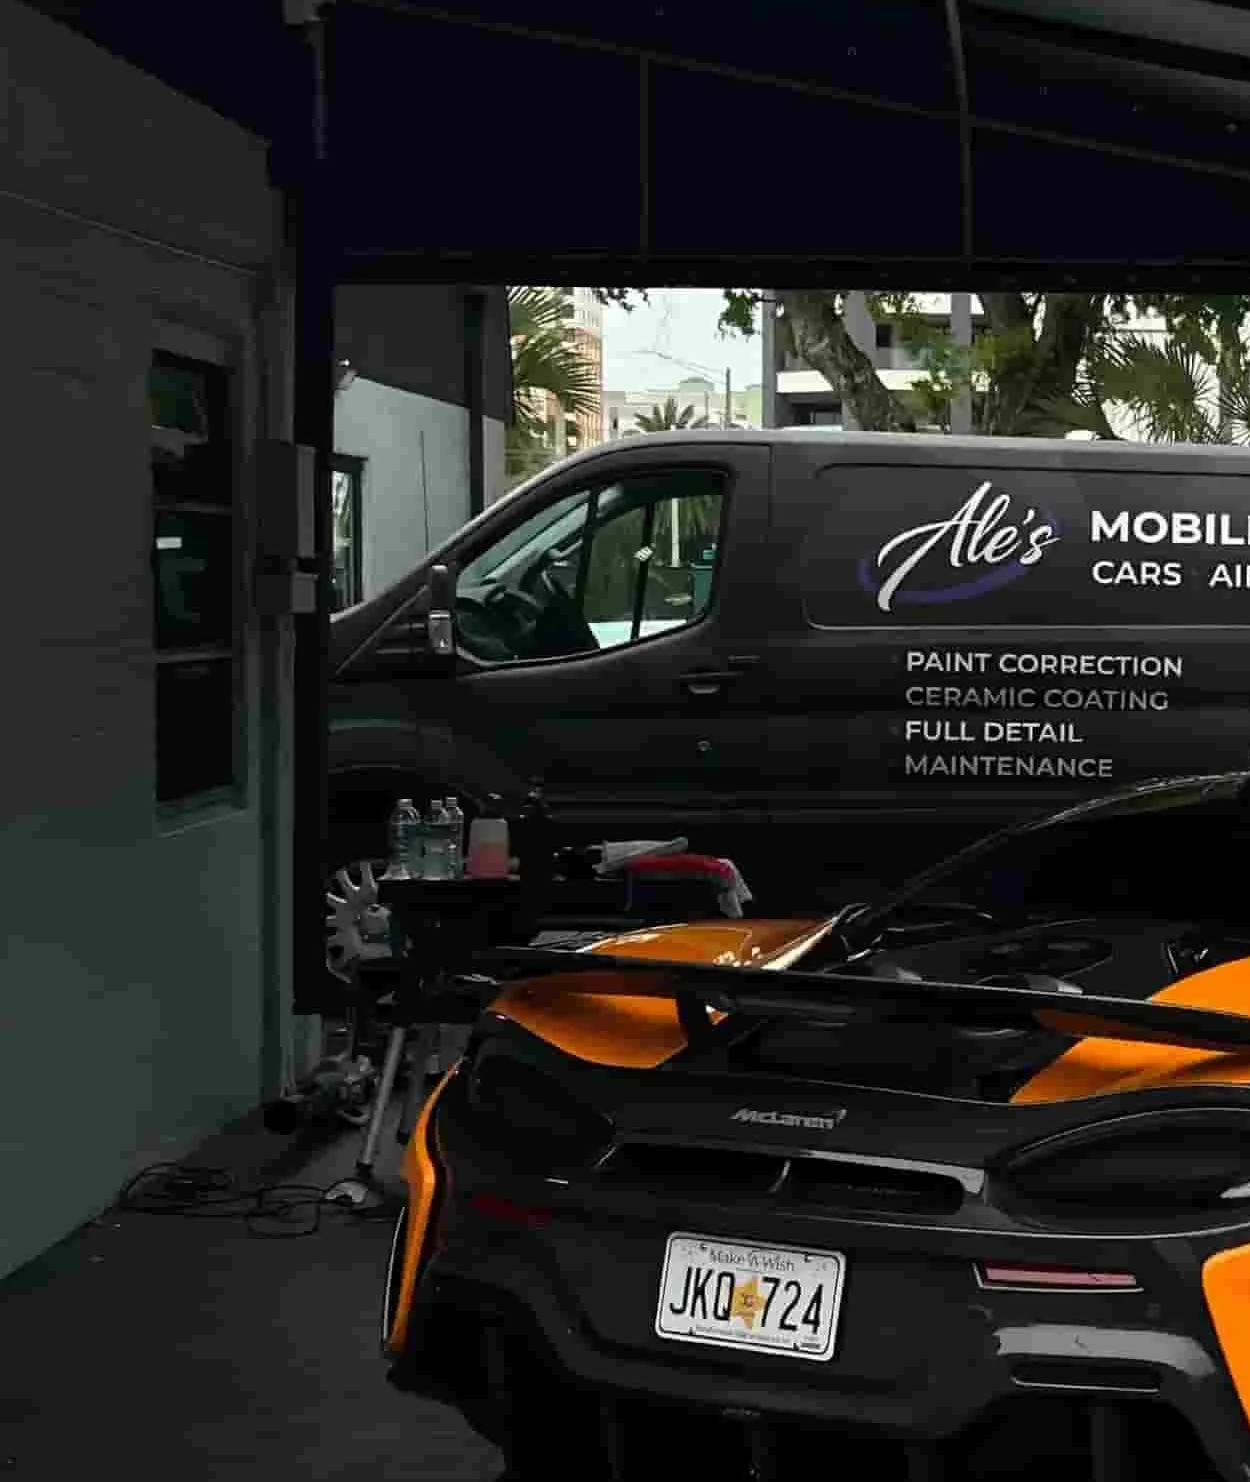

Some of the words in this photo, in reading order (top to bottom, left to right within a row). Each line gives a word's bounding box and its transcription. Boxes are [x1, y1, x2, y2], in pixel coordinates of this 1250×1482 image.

[877, 480, 1060, 612] Ale's
[1092, 560, 1182, 587] CARS
[906, 651, 993, 674] PAINT
[998, 653, 1184, 679] CORRECTION
[905, 686, 1037, 709] CERAMIC
[1044, 688, 1170, 712] COATING
[905, 720, 977, 744] FULL
[984, 721, 1084, 744] DETAIL
[905, 754, 1114, 779] MAINTENANCE
[669, 1266, 736, 1321] JKQ
[761, 1276, 825, 1335] 724
